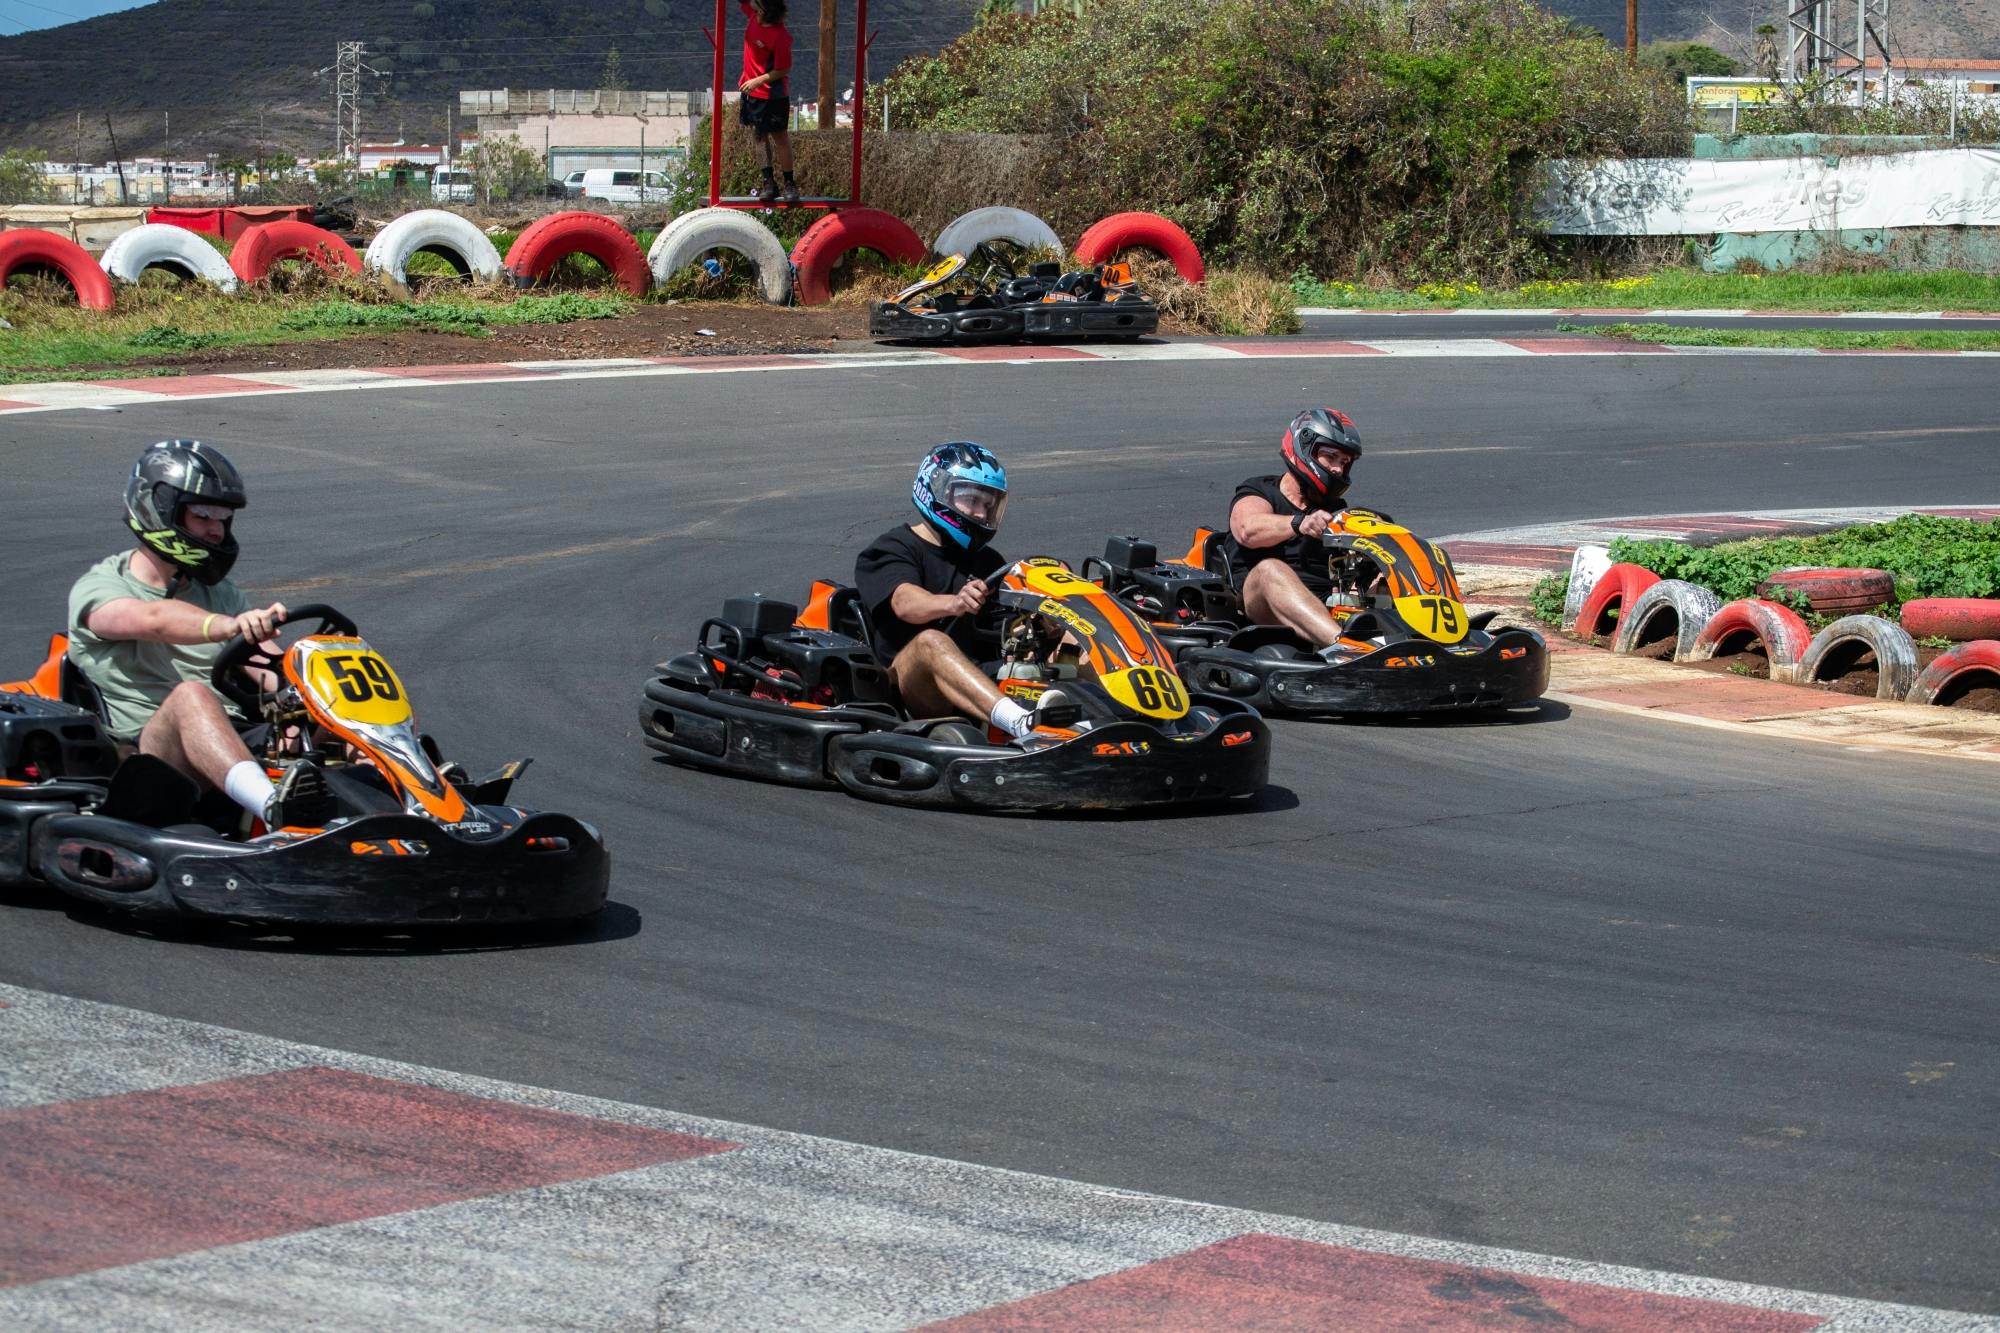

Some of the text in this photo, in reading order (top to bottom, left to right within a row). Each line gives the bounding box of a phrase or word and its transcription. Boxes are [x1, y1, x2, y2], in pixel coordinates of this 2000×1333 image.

[1696, 86, 1748, 95] Conforama
[1351, 537, 1397, 565] CRG
[1038, 599, 1098, 637] CRG
[1420, 598, 1459, 635] 79
[324, 655, 400, 702] 59
[1127, 668, 1184, 713] 69
